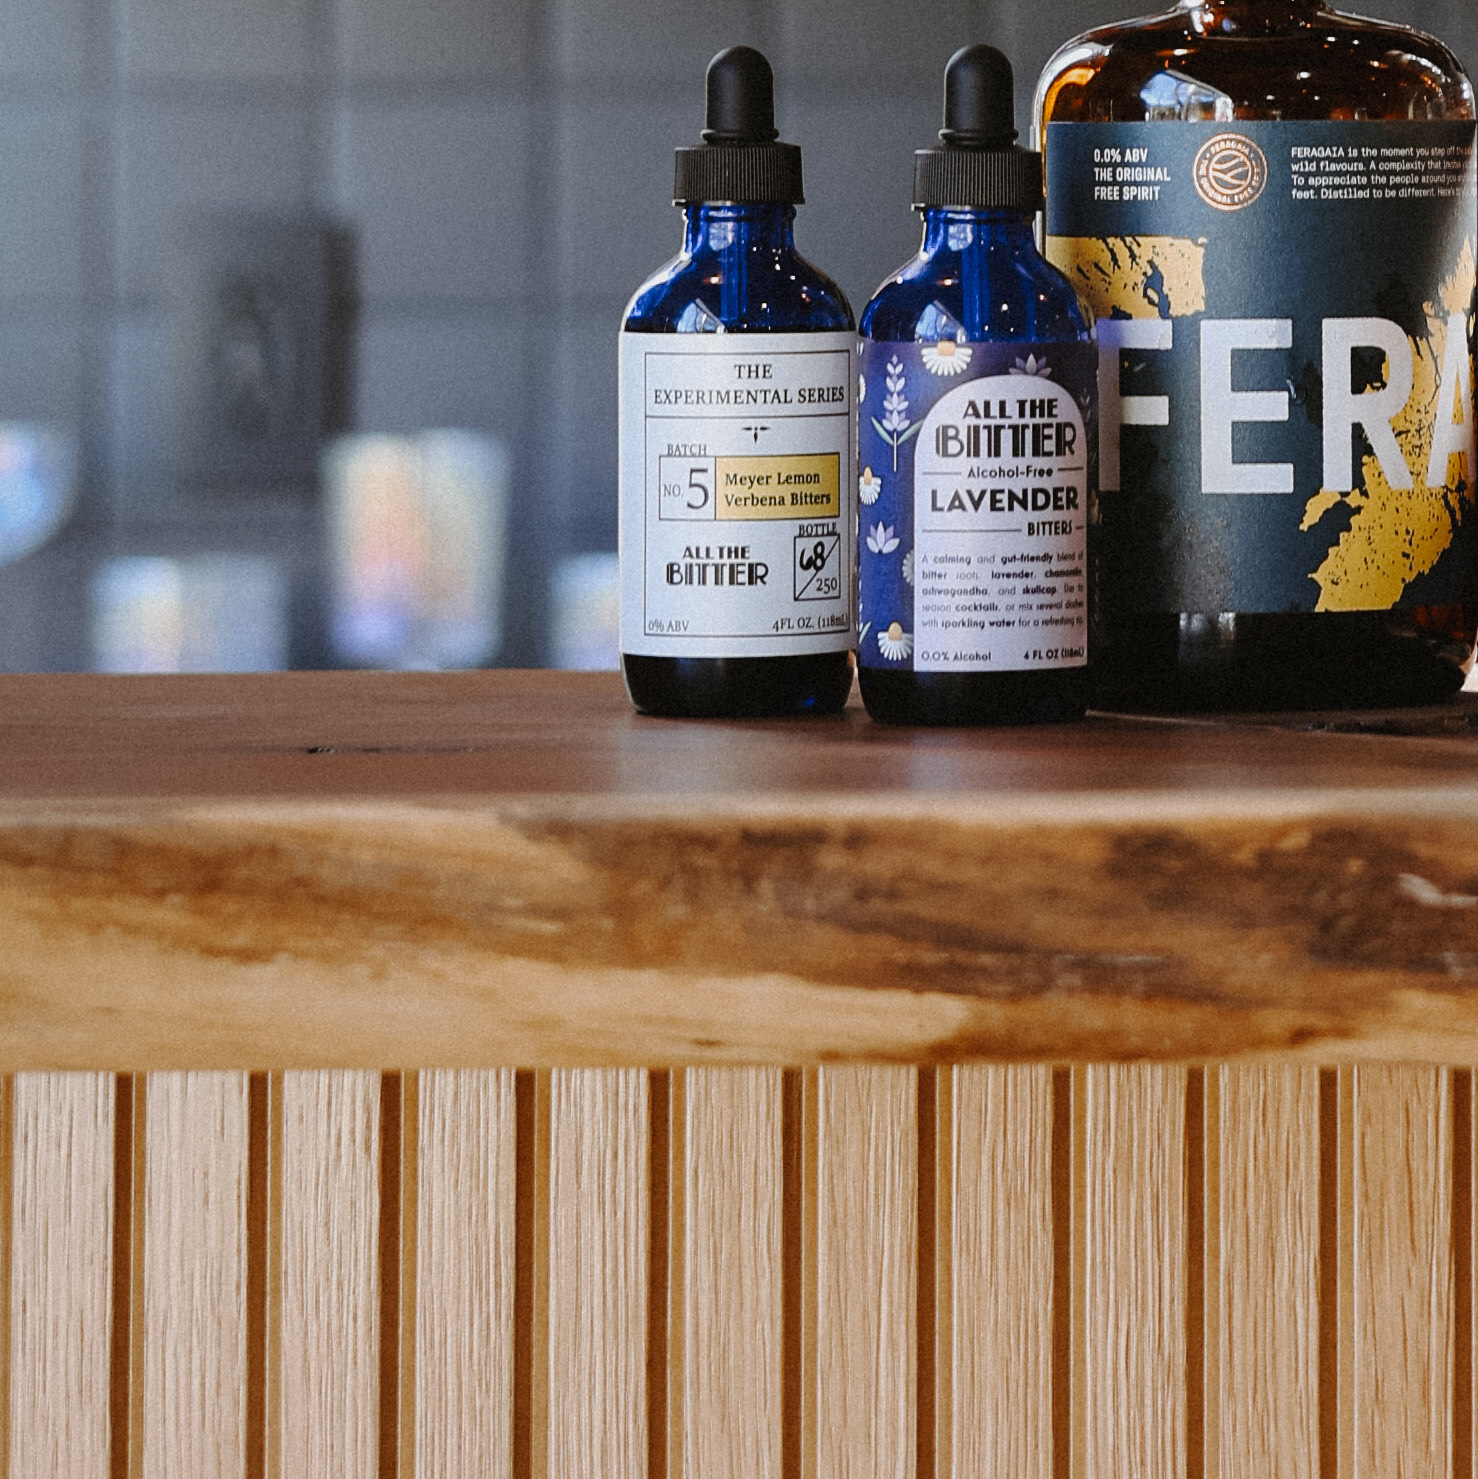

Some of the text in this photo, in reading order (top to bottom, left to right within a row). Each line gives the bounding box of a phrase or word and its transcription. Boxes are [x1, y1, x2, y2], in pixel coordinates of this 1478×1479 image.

[1093, 147, 1149, 163] 0.0% ABV
[1291, 146, 1345, 158] FERAGAIA
[1347, 146, 1358, 158] is
[1361, 146, 1378, 157] the
[1380, 147, 1413, 157] moment
[1416, 147, 1429, 159] you
[1431, 146, 1446, 158] step
[1291, 161, 1316, 172] wild
[1320, 160, 1367, 172] flavours.
[1369, 160, 1377, 171] A
[1379, 159, 1426, 172] complexity
[1428, 159, 1441, 170] that
[1094, 167, 1171, 182] THE ORIGINAL
[1291, 174, 1304, 186] To
[1308, 174, 1367, 188] appreciate
[1371, 174, 1387, 185] the
[1389, 174, 1419, 187] people
[1421, 174, 1446, 183] around
[1447, 174, 1456, 185] you
[1094, 185, 1161, 201] FREE SPIRIT
[1291, 188, 1317, 200] feet.
[1321, 188, 1370, 199] Distilled
[1372, 188, 1383, 199] to
[1385, 187, 1397, 199] be
[734, 364, 773, 379] THE
[654, 386, 845, 405] EXPERIMENTAL SERIES
[963, 398, 1058, 419] ALL THE
[936, 422, 1077, 458] BITTER
[667, 444, 707, 457] BATCH
[967, 465, 1054, 479] Alcohol-Free
[725, 472, 820, 489] Meyer Lemon
[663, 468, 709, 510] NO. 5
[725, 492, 831, 507] Verbena Bitters
[931, 487, 1079, 512] LAVENDER
[798, 523, 838, 536] BOTTLE
[1027, 520, 1072, 536] BITTERS
[682, 546, 750, 559] ALL THE
[922, 554, 928, 563] A
[934, 553, 971, 565] calming
[977, 553, 995, 563] and
[1001, 552, 1053, 565] gut-friendly
[666, 562, 769, 586] BITTER
[922, 570, 947, 580] bitter
[991, 569, 1036, 581] lavender,
[816, 578, 838, 594] 250
[922, 585, 991, 598] ashwagandha,
[998, 585, 1016, 595] and
[922, 603, 952, 612] season
[1005, 603, 1015, 612] or
[1019, 602, 1033, 611] mix
[648, 620, 690, 632] 0% ABV
[797, 617, 815, 630] OZ.
[922, 617, 938, 628] with
[942, 617, 985, 630] sparkling
[989, 617, 1016, 628] water
[1019, 617, 1031, 627] for
[1033, 618, 1039, 627] a
[921, 650, 992, 662] 0.0% Alcohol
[1023, 650, 1030, 661] 4
[1032, 649, 1043, 660] FL
[1045, 648, 1059, 659] OZ
